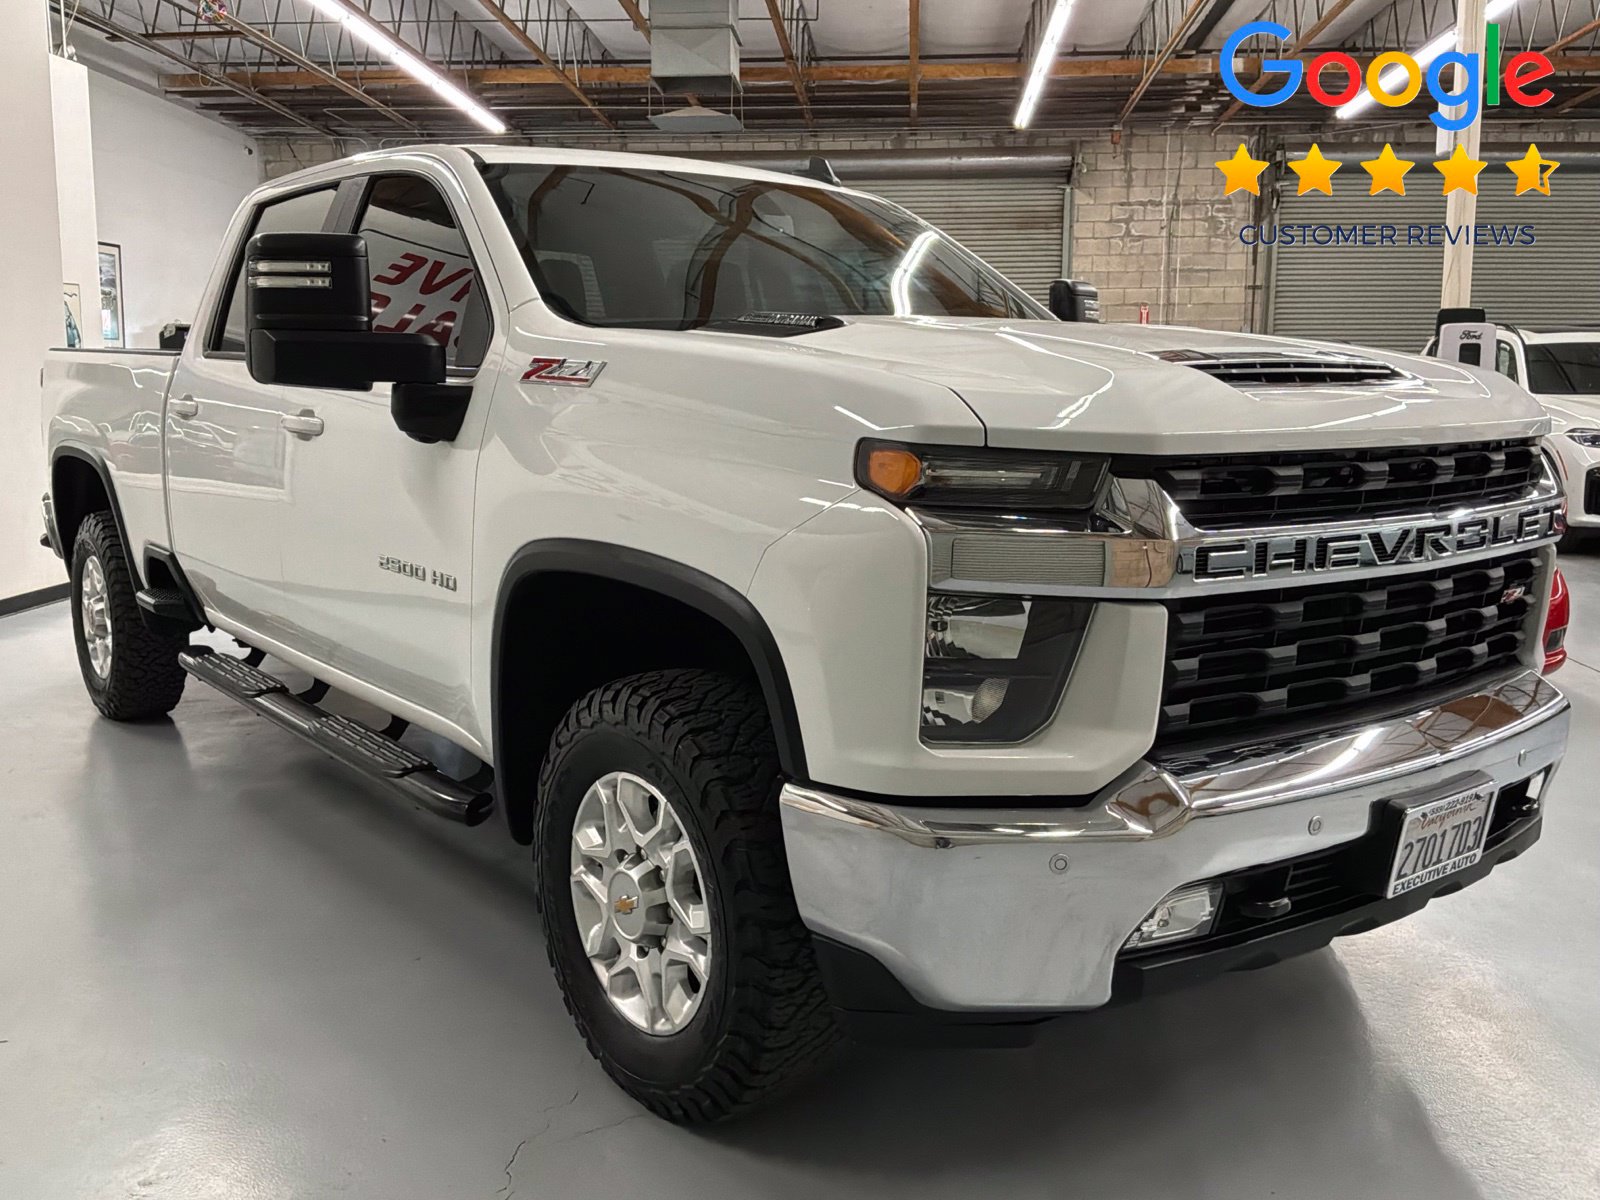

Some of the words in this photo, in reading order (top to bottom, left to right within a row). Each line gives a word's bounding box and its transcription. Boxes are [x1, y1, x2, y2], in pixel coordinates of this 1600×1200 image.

[1459, 329, 1484, 341] Ford
[1193, 503, 1562, 583] CHEVROLET
[378, 554, 426, 582] 2500
[432, 569, 458, 592] HD
[1392, 863, 1449, 895] EXECUTIVE
[1449, 853, 1477, 872] AUTO
